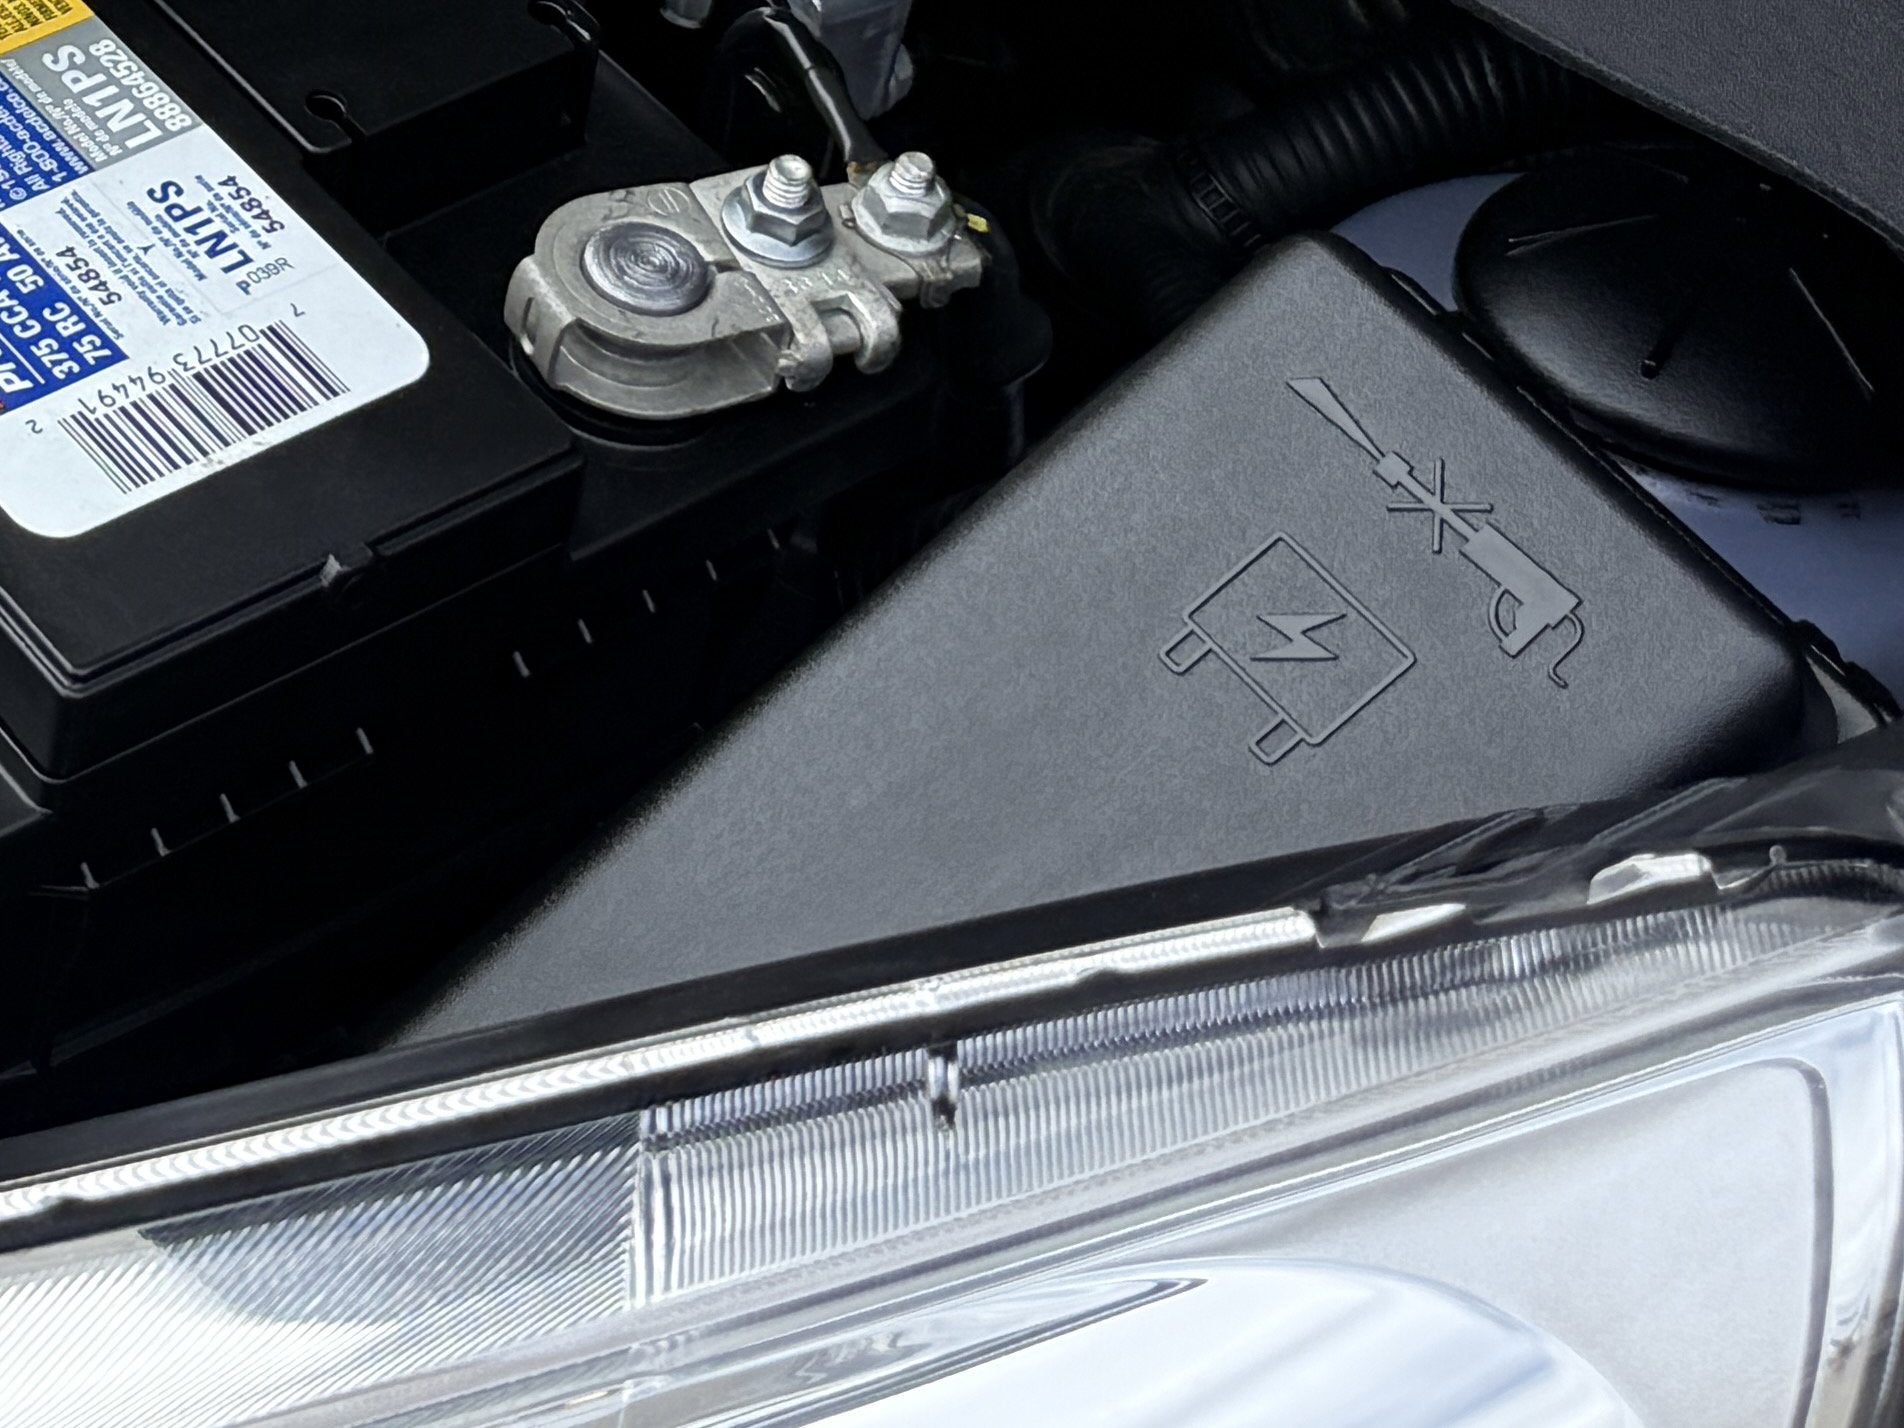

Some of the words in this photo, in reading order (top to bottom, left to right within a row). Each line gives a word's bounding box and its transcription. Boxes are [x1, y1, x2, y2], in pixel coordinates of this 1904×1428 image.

[32, 90, 53, 105] de
[38, 41, 164, 149] LN1PS
[86, 36, 195, 132] 88864528
[58, 97, 99, 132] modelo
[71, 131, 108, 162] Model
[89, 128, 111, 143] de
[23, 172, 50, 193] All
[215, 172, 287, 235] 54854
[142, 177, 255, 275] LN1PS
[3, 261, 46, 294] 50
[52, 243, 124, 308] 54854
[39, 299, 87, 337] RC
[285, 301, 304, 317] 7
[28, 335, 82, 380] 375
[70, 332, 114, 366] 75
[169, 321, 261, 373] 07773
[75, 363, 168, 416] 94491
[23, 418, 44, 435] 2
